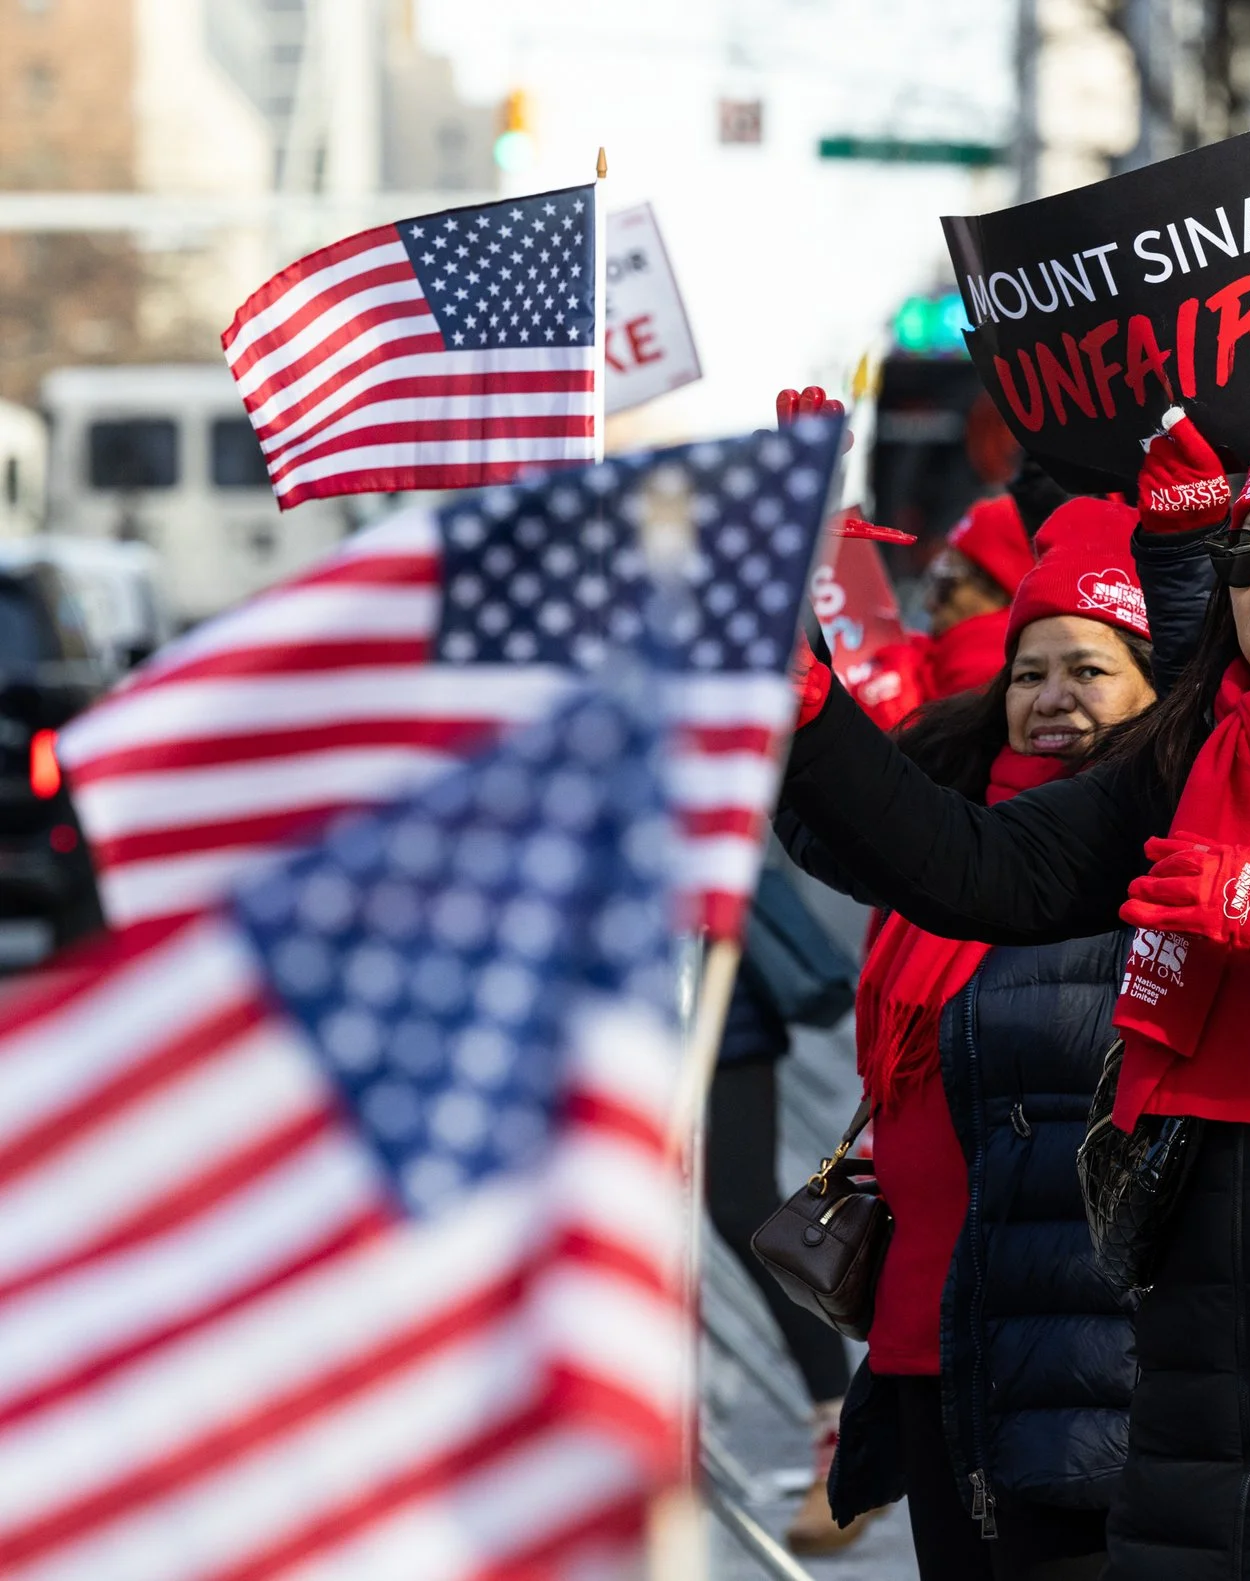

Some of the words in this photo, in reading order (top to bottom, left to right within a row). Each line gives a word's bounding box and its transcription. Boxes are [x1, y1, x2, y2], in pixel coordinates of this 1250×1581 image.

[967, 242, 1119, 325] MOUNT
[1151, 480, 1231, 506] NURSES
[1190, 480, 1207, 489] York
[1133, 928, 1188, 973] SES
[1133, 982, 1160, 999] Nurses
[1136, 975, 1168, 996] National
[1130, 989, 1157, 1006] United
